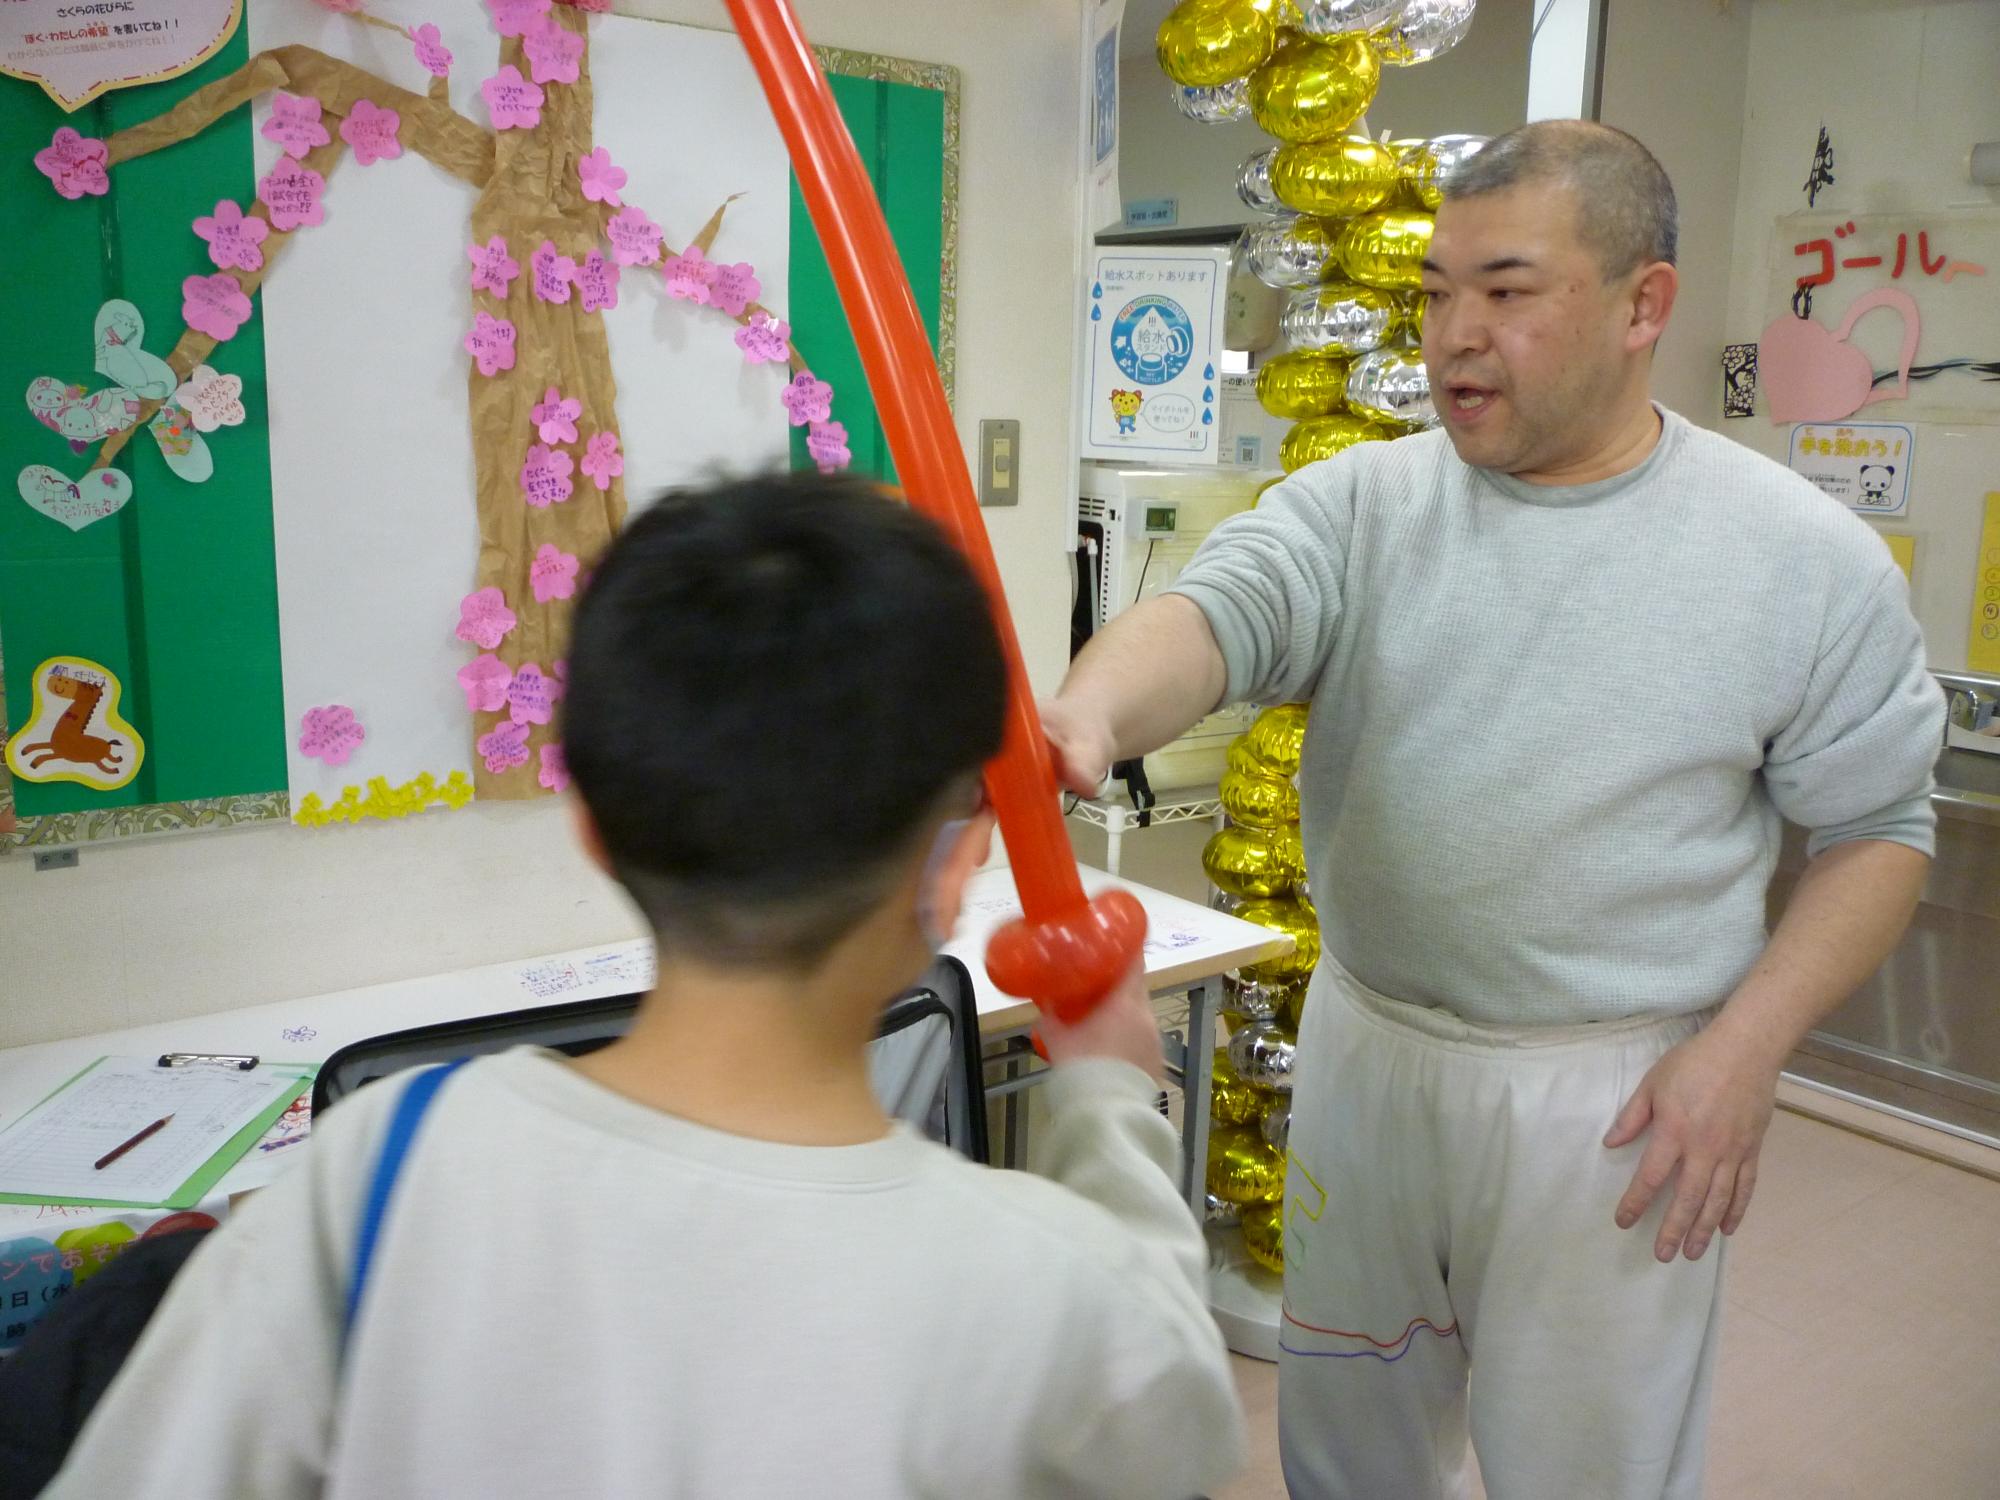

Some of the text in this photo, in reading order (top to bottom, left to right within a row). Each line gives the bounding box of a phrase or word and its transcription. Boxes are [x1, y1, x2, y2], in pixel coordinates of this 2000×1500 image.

[57, 1, 135, 18] さくらの花びらに
[1105, 270, 1208, 281] 給水スポットあります
[1137, 329, 1165, 343] 給水
[1800, 437, 1903, 457] 手を洗おう！
